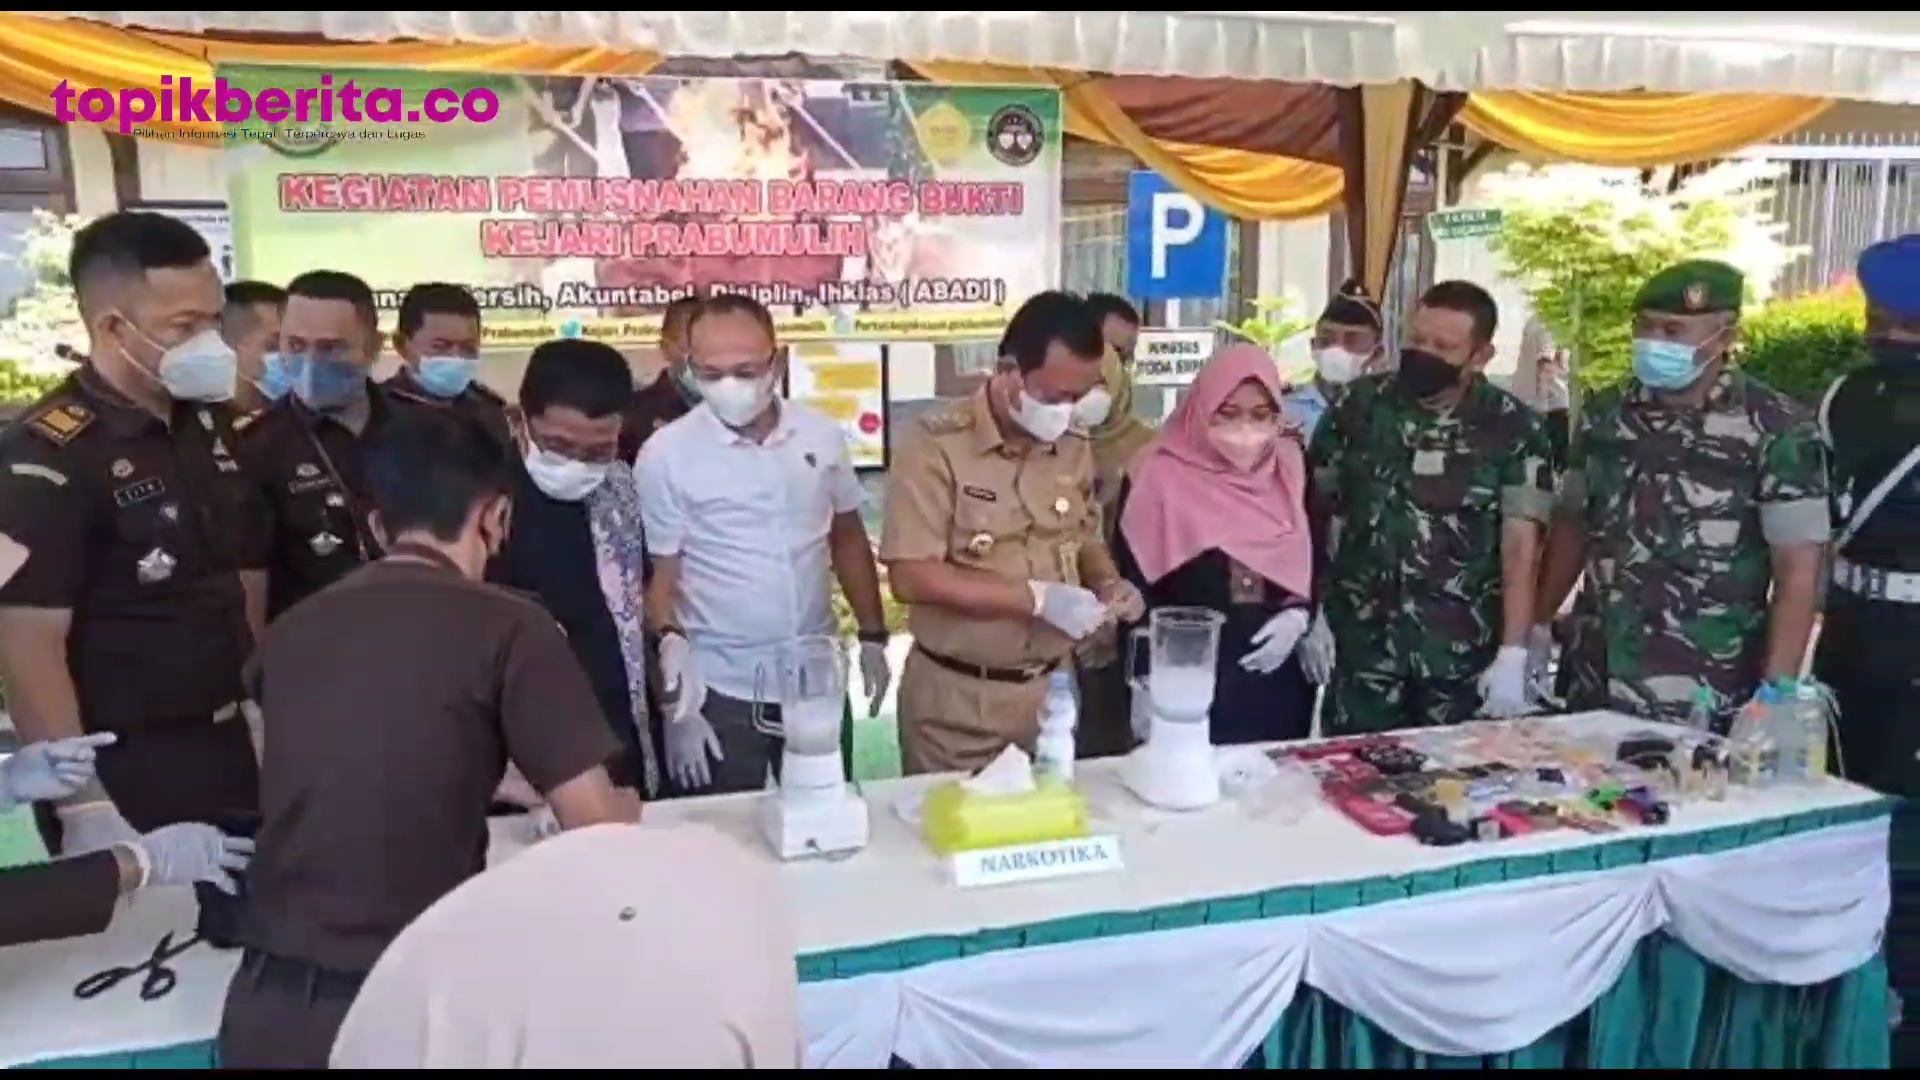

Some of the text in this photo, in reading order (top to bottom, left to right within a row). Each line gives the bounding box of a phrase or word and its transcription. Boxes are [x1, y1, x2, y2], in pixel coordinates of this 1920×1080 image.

[279, 174, 1024, 216] KEGIATAN PEMUSNAHAN BARANG BUKTI
[481, 219, 866, 257] KEJARI PRABUMULIH
[1151, 192, 1205, 278] P
[472, 282, 551, 312] ersih,
[818, 279, 895, 305] Ihklas
[914, 278, 991, 304] ABADI
[982, 845, 1107, 872] NARKOTIKA
